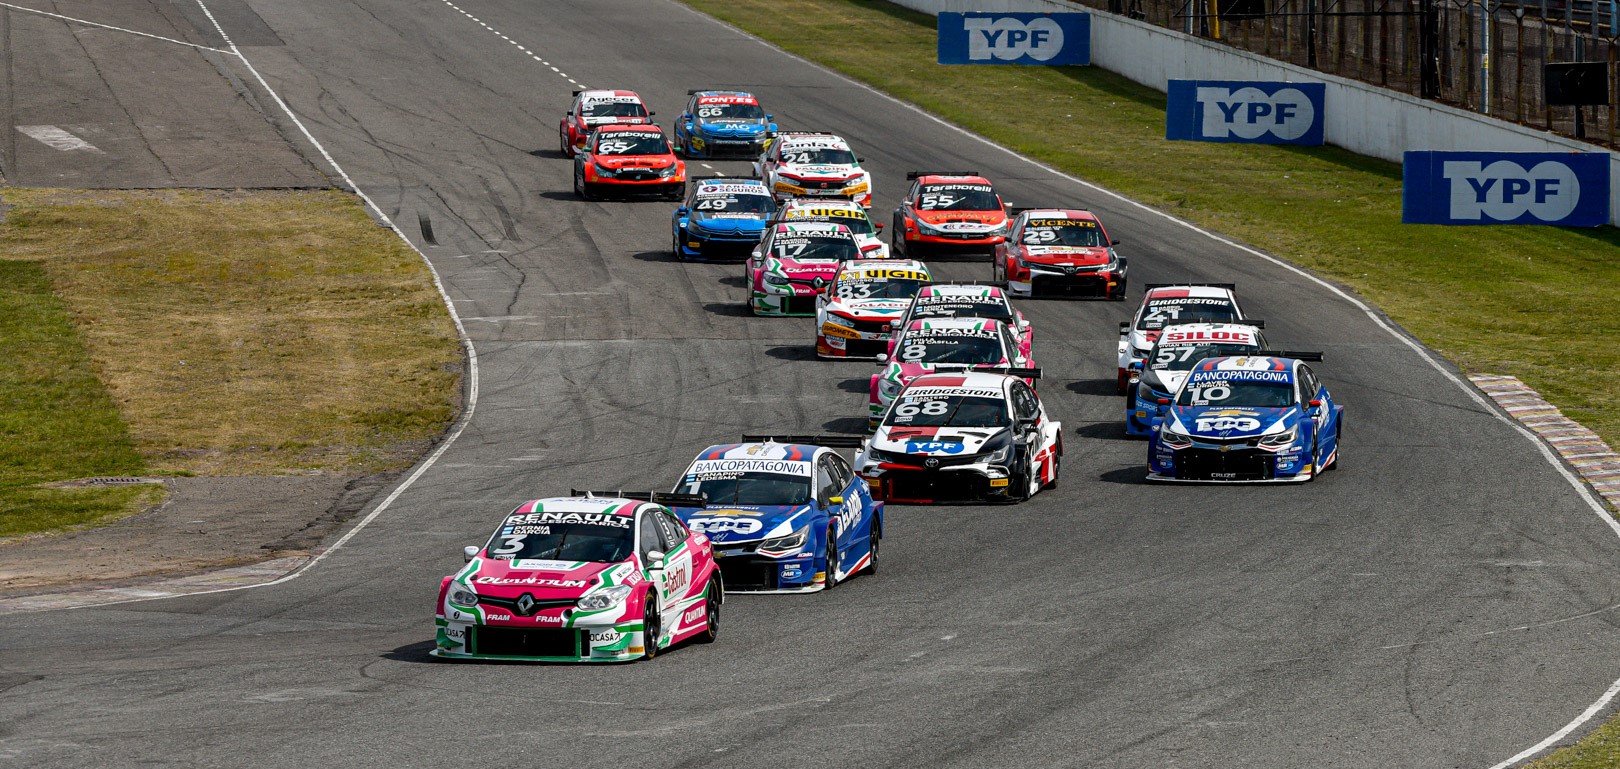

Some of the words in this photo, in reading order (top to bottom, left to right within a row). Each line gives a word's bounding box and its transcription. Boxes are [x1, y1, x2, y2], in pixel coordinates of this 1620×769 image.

[980, 30, 1050, 48] YPF
[698, 108, 723, 117] 66
[1216, 102, 1297, 124] YPF
[600, 131, 661, 139] Taraborelli
[599, 142, 629, 154] 65
[783, 152, 811, 163] 24
[924, 184, 992, 193] Taraborelli
[1465, 178, 1560, 203] YPF
[697, 200, 727, 210] 49
[922, 195, 954, 207] 55
[1030, 220, 1096, 228] VICENTE
[1023, 231, 1056, 242] 29
[774, 244, 807, 258] 17
[837, 284, 871, 299] 83
[917, 295, 1004, 304] RENAULT
[1148, 298, 1229, 307] BRIDGESTONE
[1143, 309, 1180, 322] 41
[905, 328, 998, 338] RENAULT
[1167, 331, 1250, 340] SILOC
[902, 344, 927, 360] 8
[1156, 346, 1196, 363] 57
[1194, 370, 1289, 383] BANCOPATAGONIA
[906, 388, 1002, 398] BRIDGESTONE
[1187, 387, 1231, 406] 10
[895, 401, 948, 416] 68
[913, 442, 957, 450] YPF
[694, 460, 805, 475] BANCOPATAGONIA
[685, 482, 702, 495] 1
[505, 511, 635, 527] RENAULT
[505, 519, 631, 529] CONCESIONARIOS
[493, 534, 528, 554] 3
[476, 576, 587, 588] QUANTUM
[667, 562, 687, 594] Castrol
[684, 605, 706, 625] QUANTUM
[590, 632, 615, 641] OCASA
